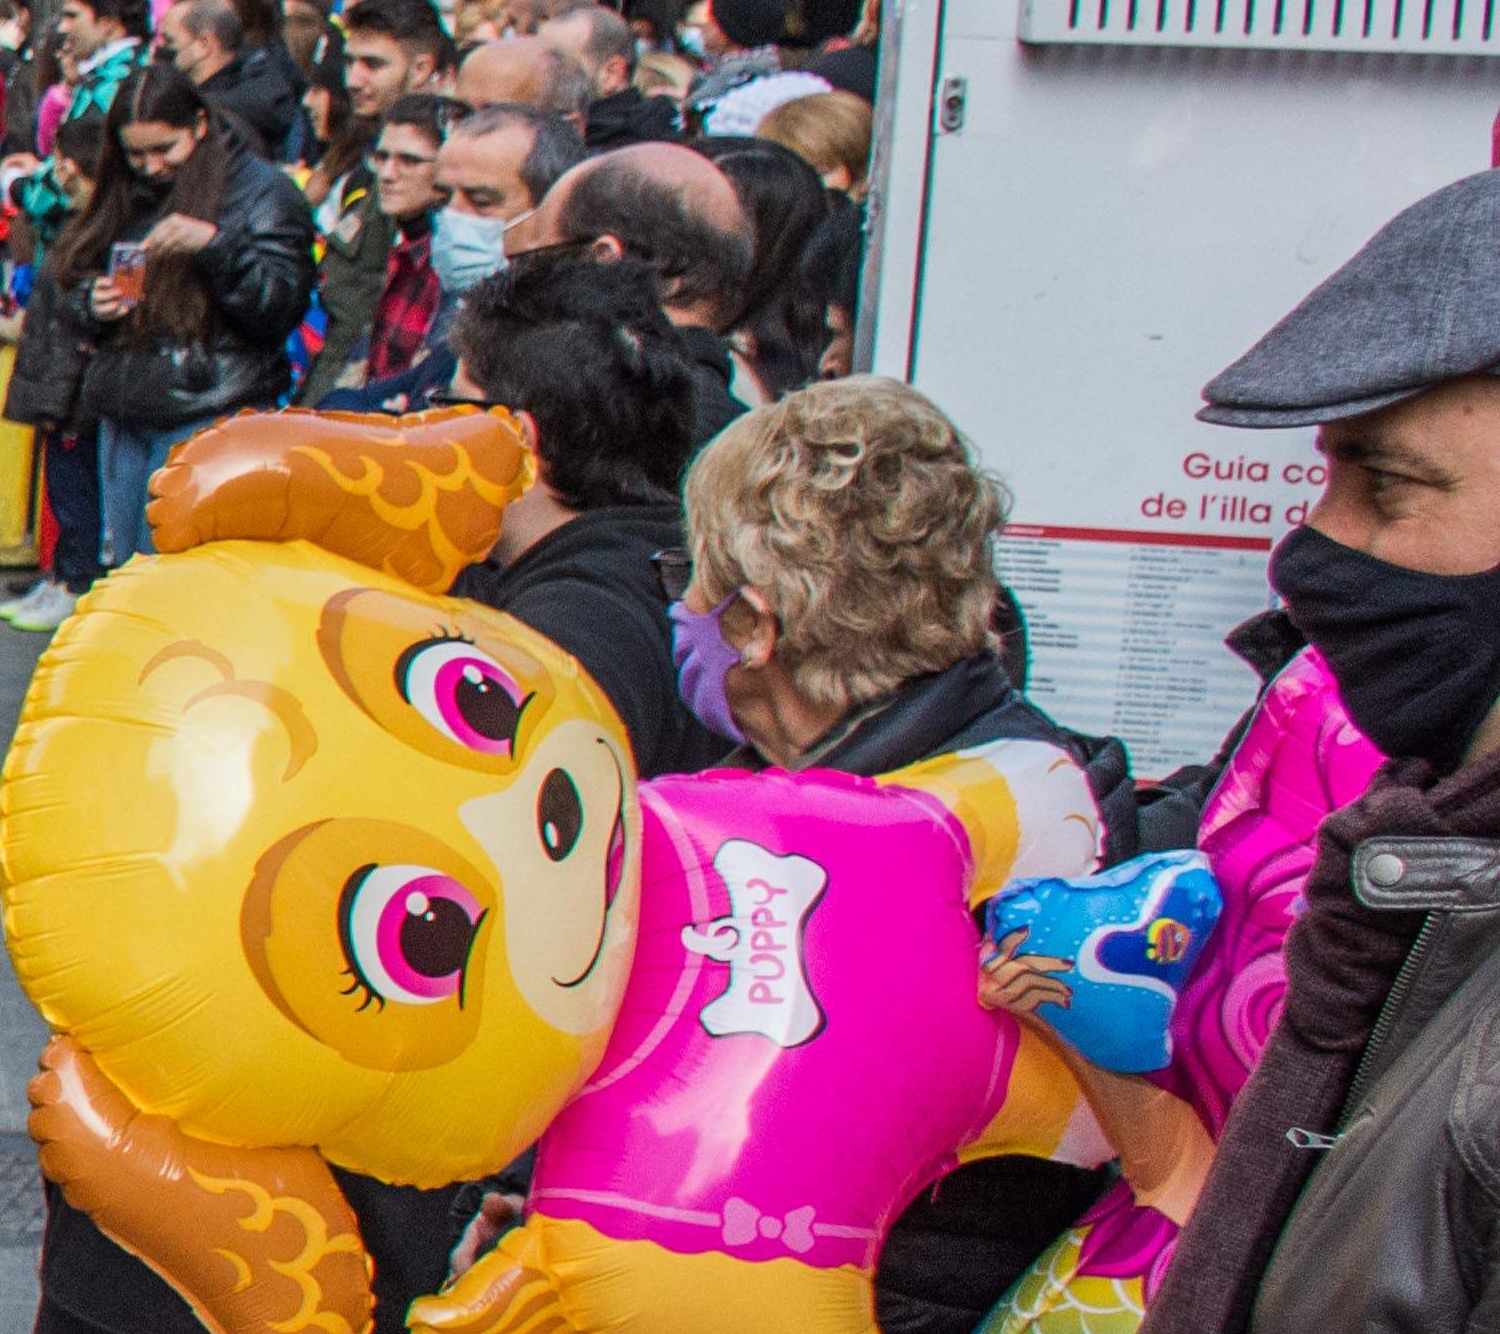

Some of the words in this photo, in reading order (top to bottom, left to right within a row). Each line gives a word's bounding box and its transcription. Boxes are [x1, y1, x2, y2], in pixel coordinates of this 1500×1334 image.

[1183, 451, 1270, 482] Guia
[1140, 492, 1188, 519] de
[748, 877, 789, 1005] PUPPY
